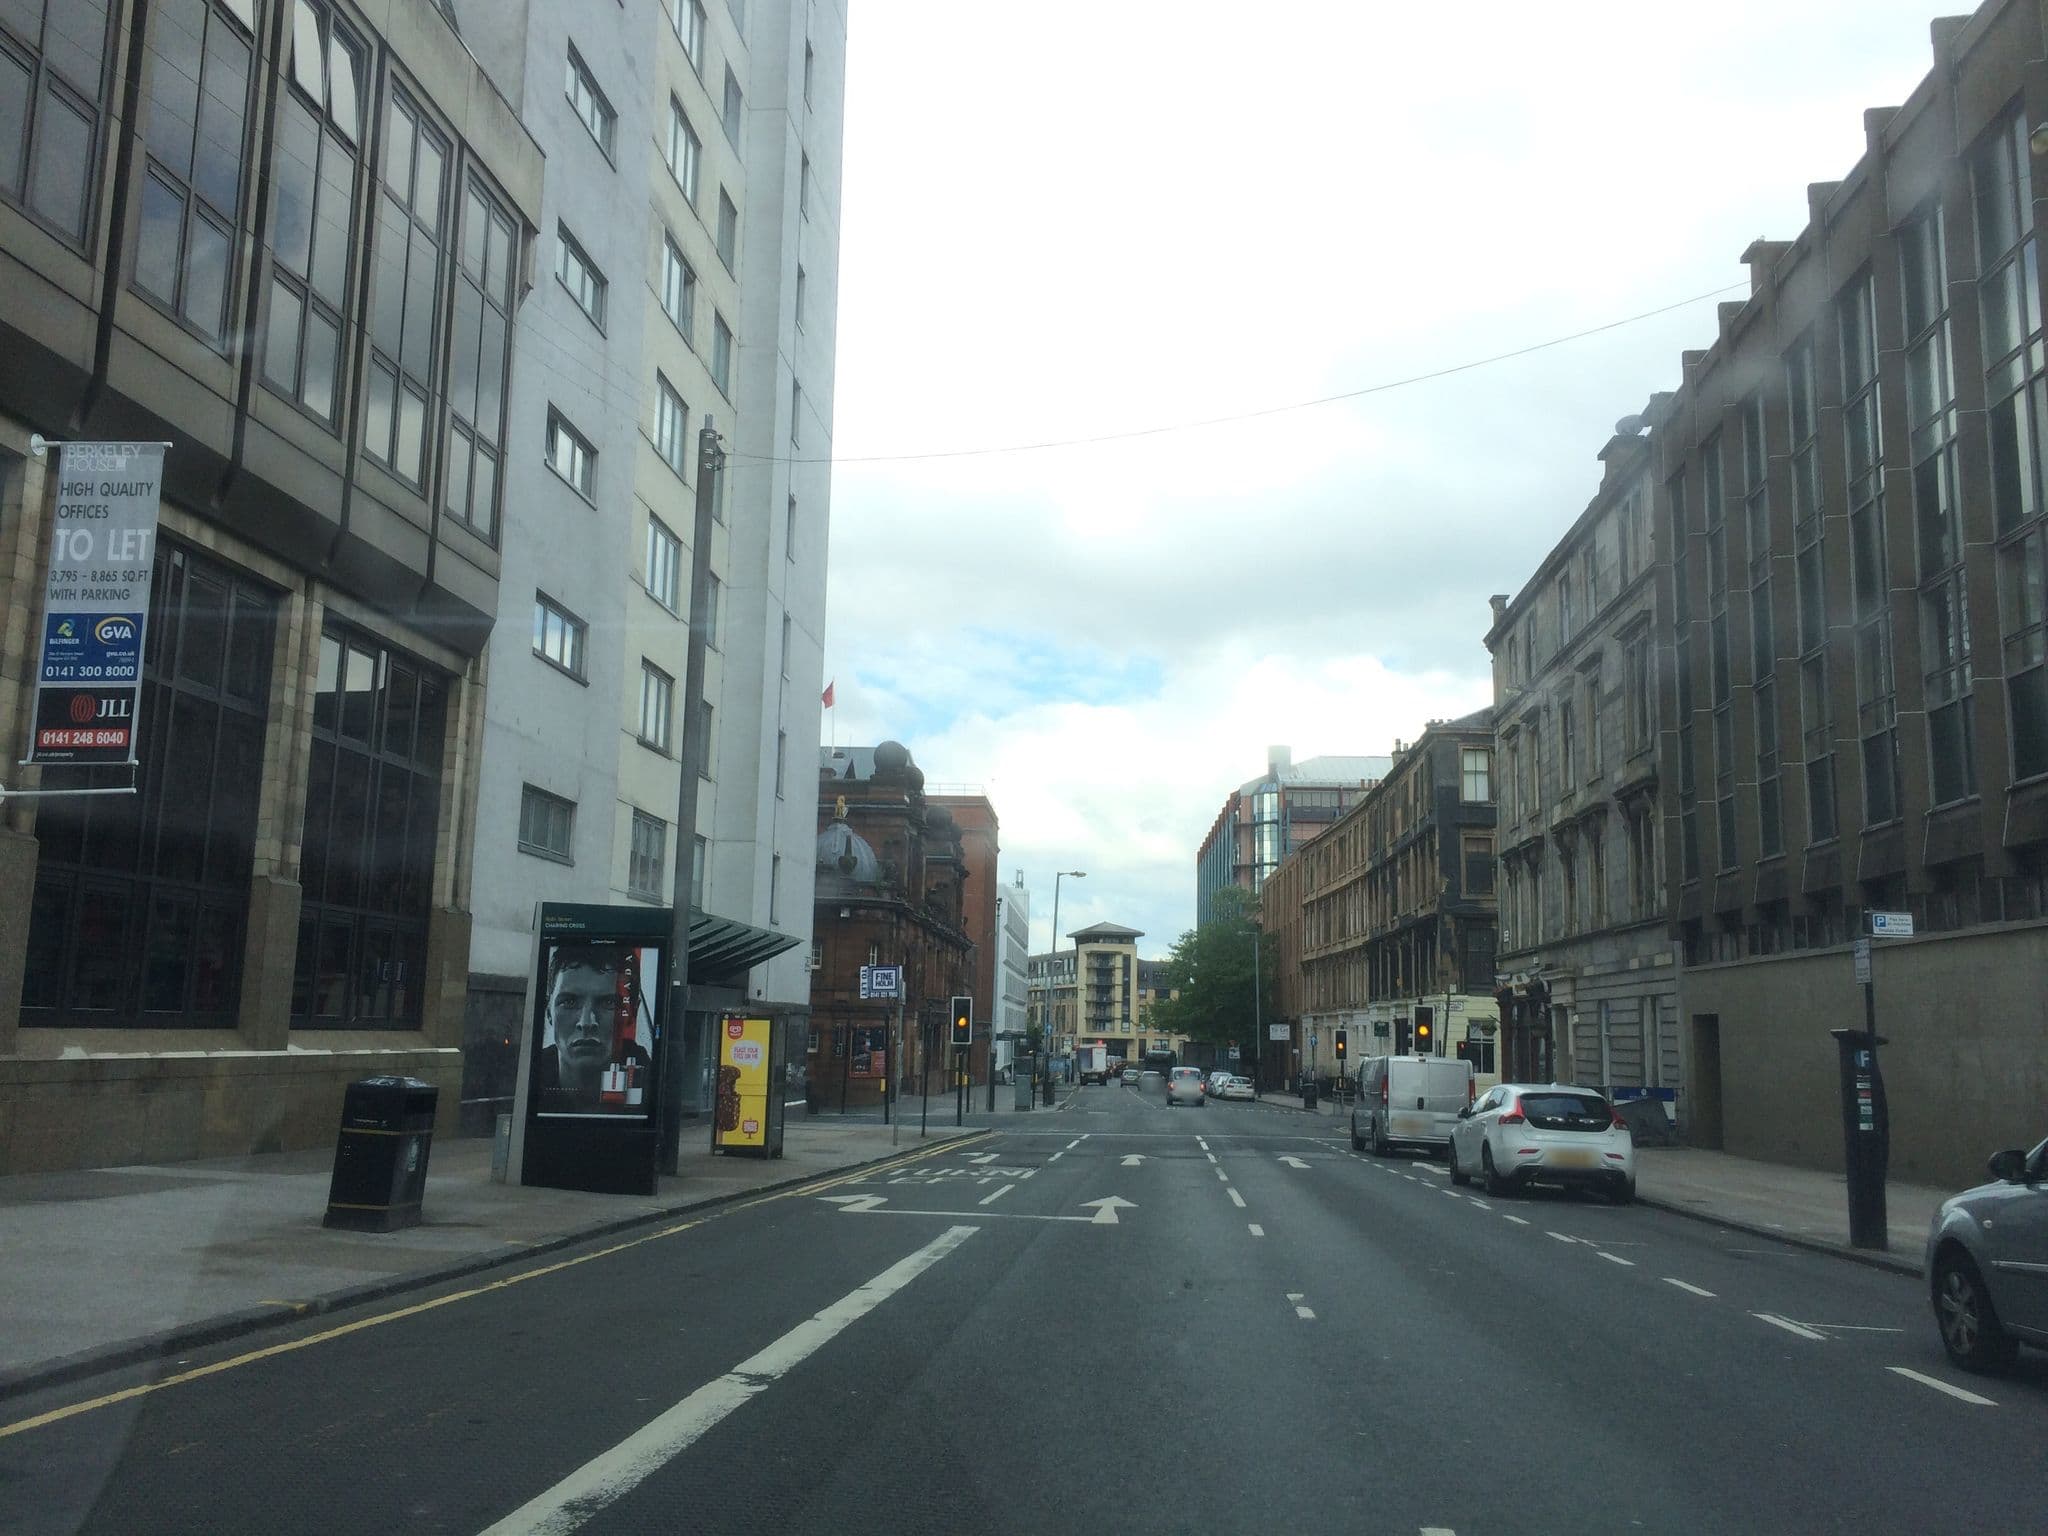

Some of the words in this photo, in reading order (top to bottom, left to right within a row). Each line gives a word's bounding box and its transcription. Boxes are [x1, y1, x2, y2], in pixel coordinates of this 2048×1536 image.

[66, 444, 141, 458] BERKELEY
[65, 457, 116, 472] HOUSE
[60, 482, 94, 497] HIGH
[99, 482, 154, 497] QUALITY
[58, 504, 109, 519] OFFICES
[56, 528, 94, 561] TO
[107, 529, 151, 561] LET
[50, 570, 78, 583] 3,795
[90, 570, 118, 583] 8,865
[50, 588, 77, 600] WITH
[81, 588, 131, 600] PARKING
[101, 626, 132, 639] GVA
[46, 666, 74, 677] 0141
[79, 666, 102, 677] 300
[105, 666, 135, 677] 8000
[96, 699, 130, 718] JLL
[43, 732, 69, 744] 0141
[72, 732, 93, 744] 248
[96, 731, 124, 744] 6040
[1877, 917, 1885, 926] P
[861, 968, 868, 980] TO
[876, 972, 894, 981] FINE
[621, 955, 633, 1017] PRADA
